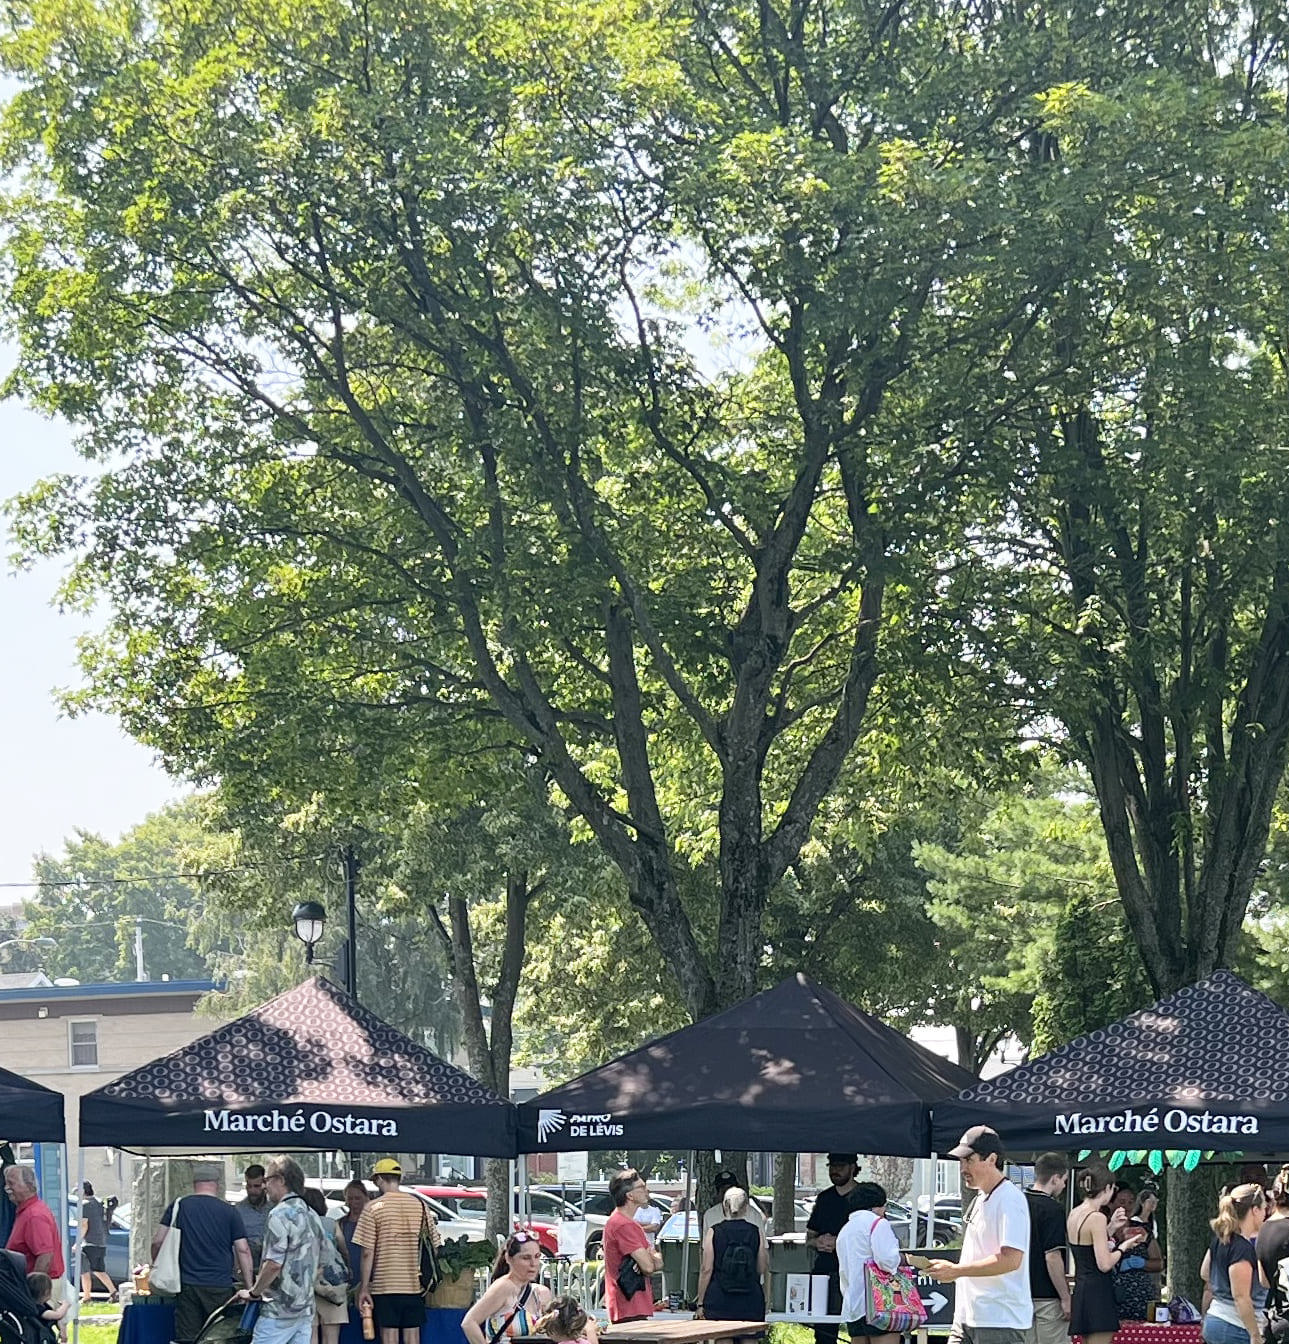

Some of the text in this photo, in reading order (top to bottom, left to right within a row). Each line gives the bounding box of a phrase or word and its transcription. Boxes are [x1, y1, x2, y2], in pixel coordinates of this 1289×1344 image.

[203, 1109, 399, 1136] Marché Ostara
[570, 1123, 624, 1137] DE LÉVIS
[1053, 1107, 1260, 1135] Marché Ostara
